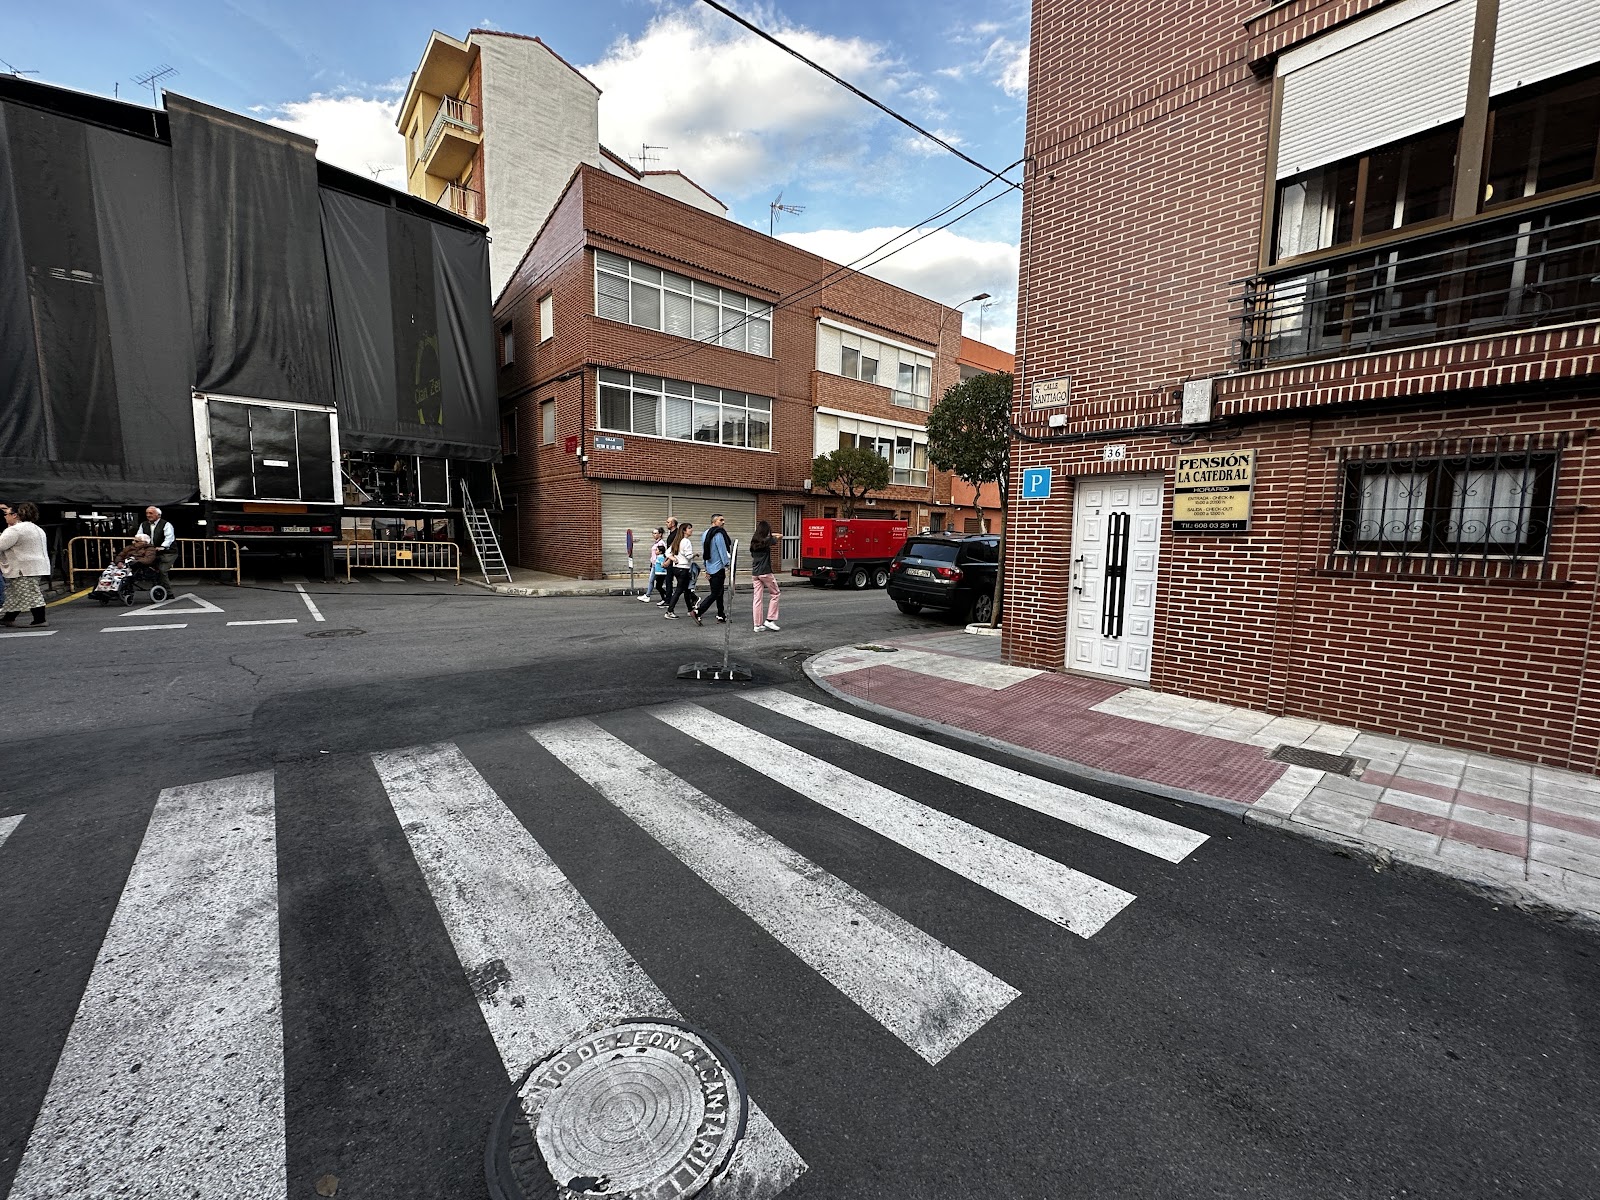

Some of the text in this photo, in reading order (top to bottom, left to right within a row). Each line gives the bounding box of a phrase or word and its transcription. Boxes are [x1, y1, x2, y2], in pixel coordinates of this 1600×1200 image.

[1043, 382, 1059, 391] CALLE
[1034, 391, 1067, 405] SANTIAGO
[1107, 448, 1121, 458] 36
[1179, 453, 1249, 470] PENSIÓN
[1030, 474, 1043, 492] P
[1178, 469, 1248, 483] LA CATEDRAL
[576, 1037, 609, 1062] DE
[616, 1031, 681, 1052] LEON
